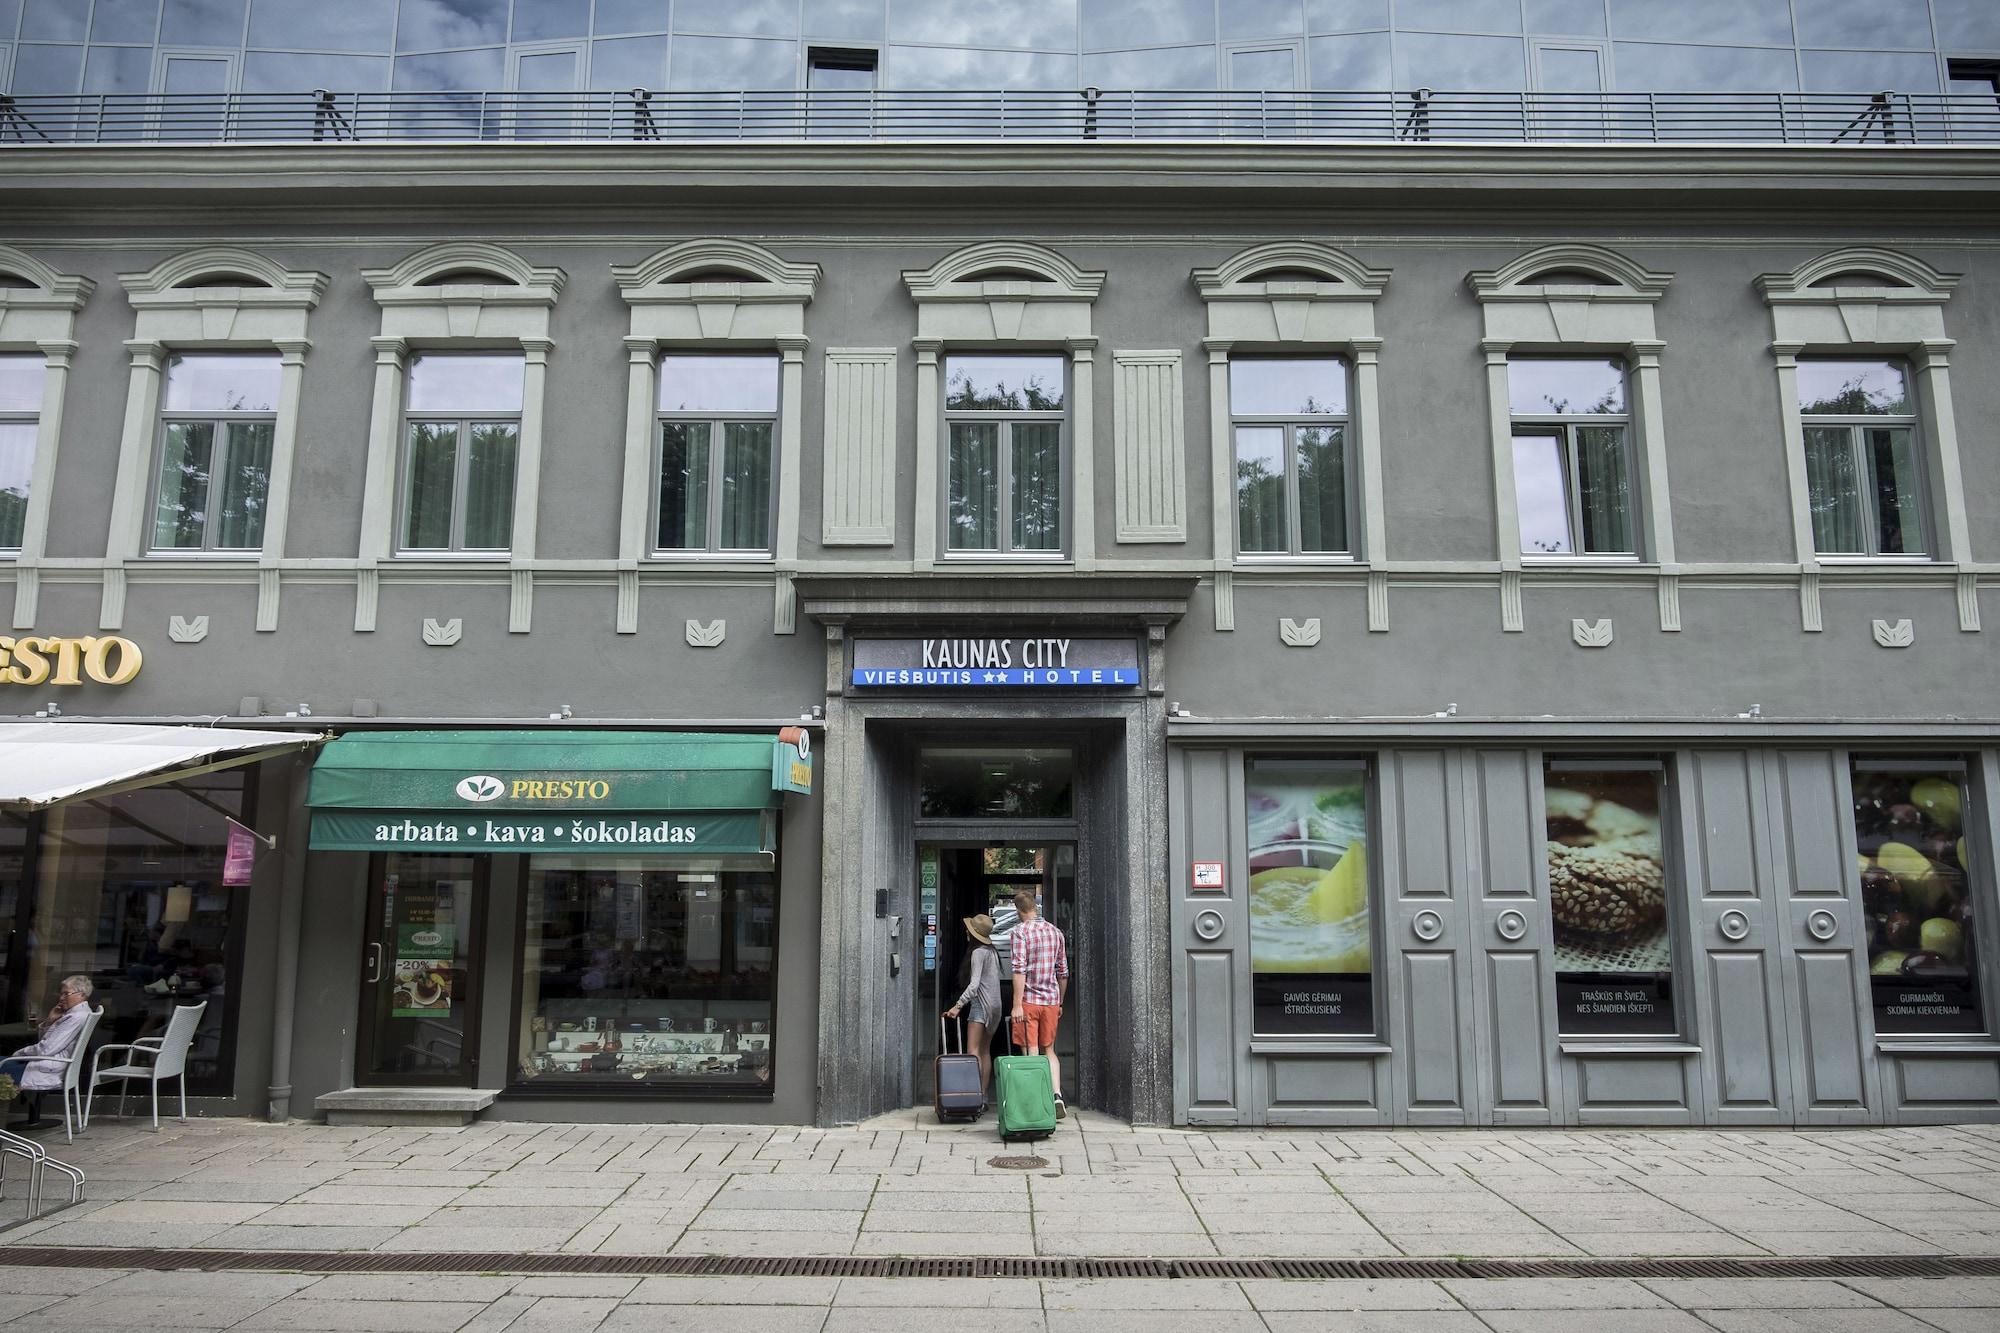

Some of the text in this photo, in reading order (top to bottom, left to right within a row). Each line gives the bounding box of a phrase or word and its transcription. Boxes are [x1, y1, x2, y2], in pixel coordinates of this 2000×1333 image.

[922, 639, 1070, 668] KAUNAS CITY
[865, 669, 1124, 684] VIEŠBUTIS HOTEL
[510, 780, 609, 799] PRESTO
[375, 820, 696, 843] arbata kava šokoladas
[397, 961, 430, 970] -20%
[1283, 992, 1342, 1002] GAIVŪS GĖRIMAI
[1581, 990, 1648, 1002] TRAŠKŪS IR ŠVIEŽI,
[1900, 992, 1945, 1003] GURMANIŠKI
[1284, 1003, 1341, 1014] IŠTROŠKUSIEMS
[1576, 1002, 1654, 1013] NES ŠIANDIEN IŠKEPTI
[1887, 1006, 1960, 1015] SKONIAI KIEKVIENAM
